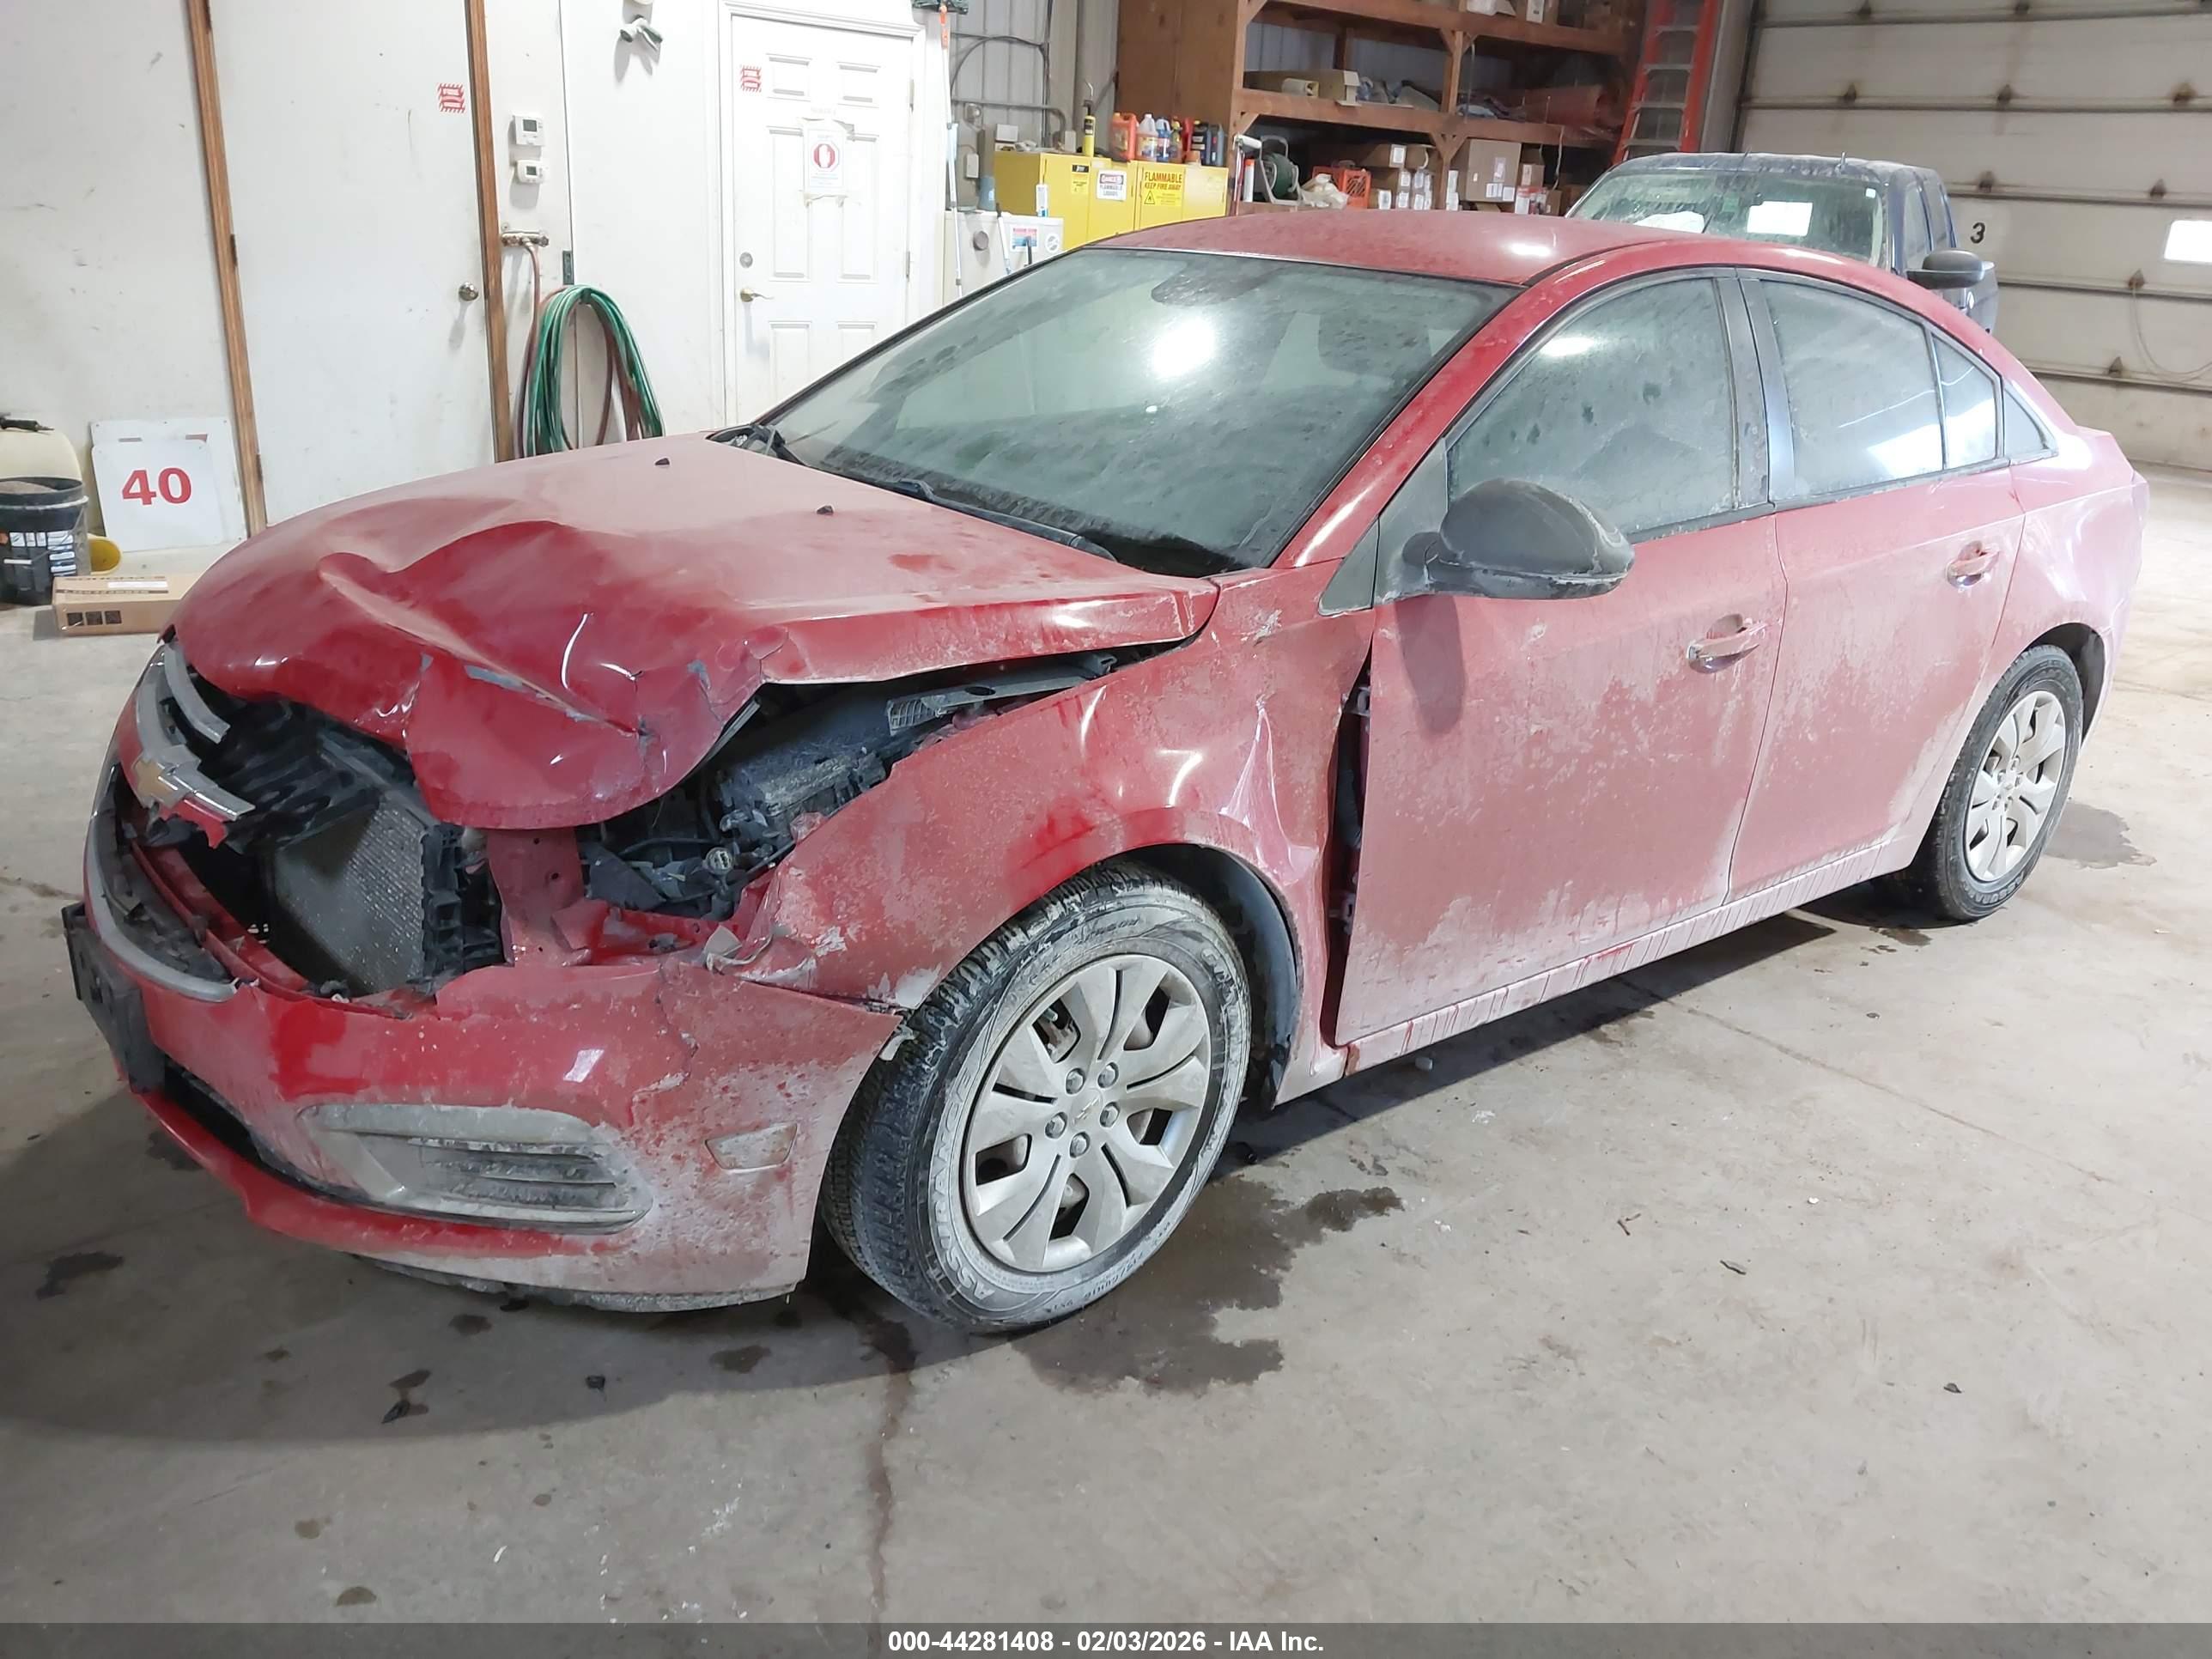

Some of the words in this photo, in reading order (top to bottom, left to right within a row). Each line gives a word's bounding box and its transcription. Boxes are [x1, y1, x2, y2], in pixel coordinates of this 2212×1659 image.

[1145, 171, 1182, 184] FLAMMABLE
[1970, 222, 1986, 244] 3
[122, 467, 192, 506] 40
[934, 1067, 995, 1300] ASSURANCE
